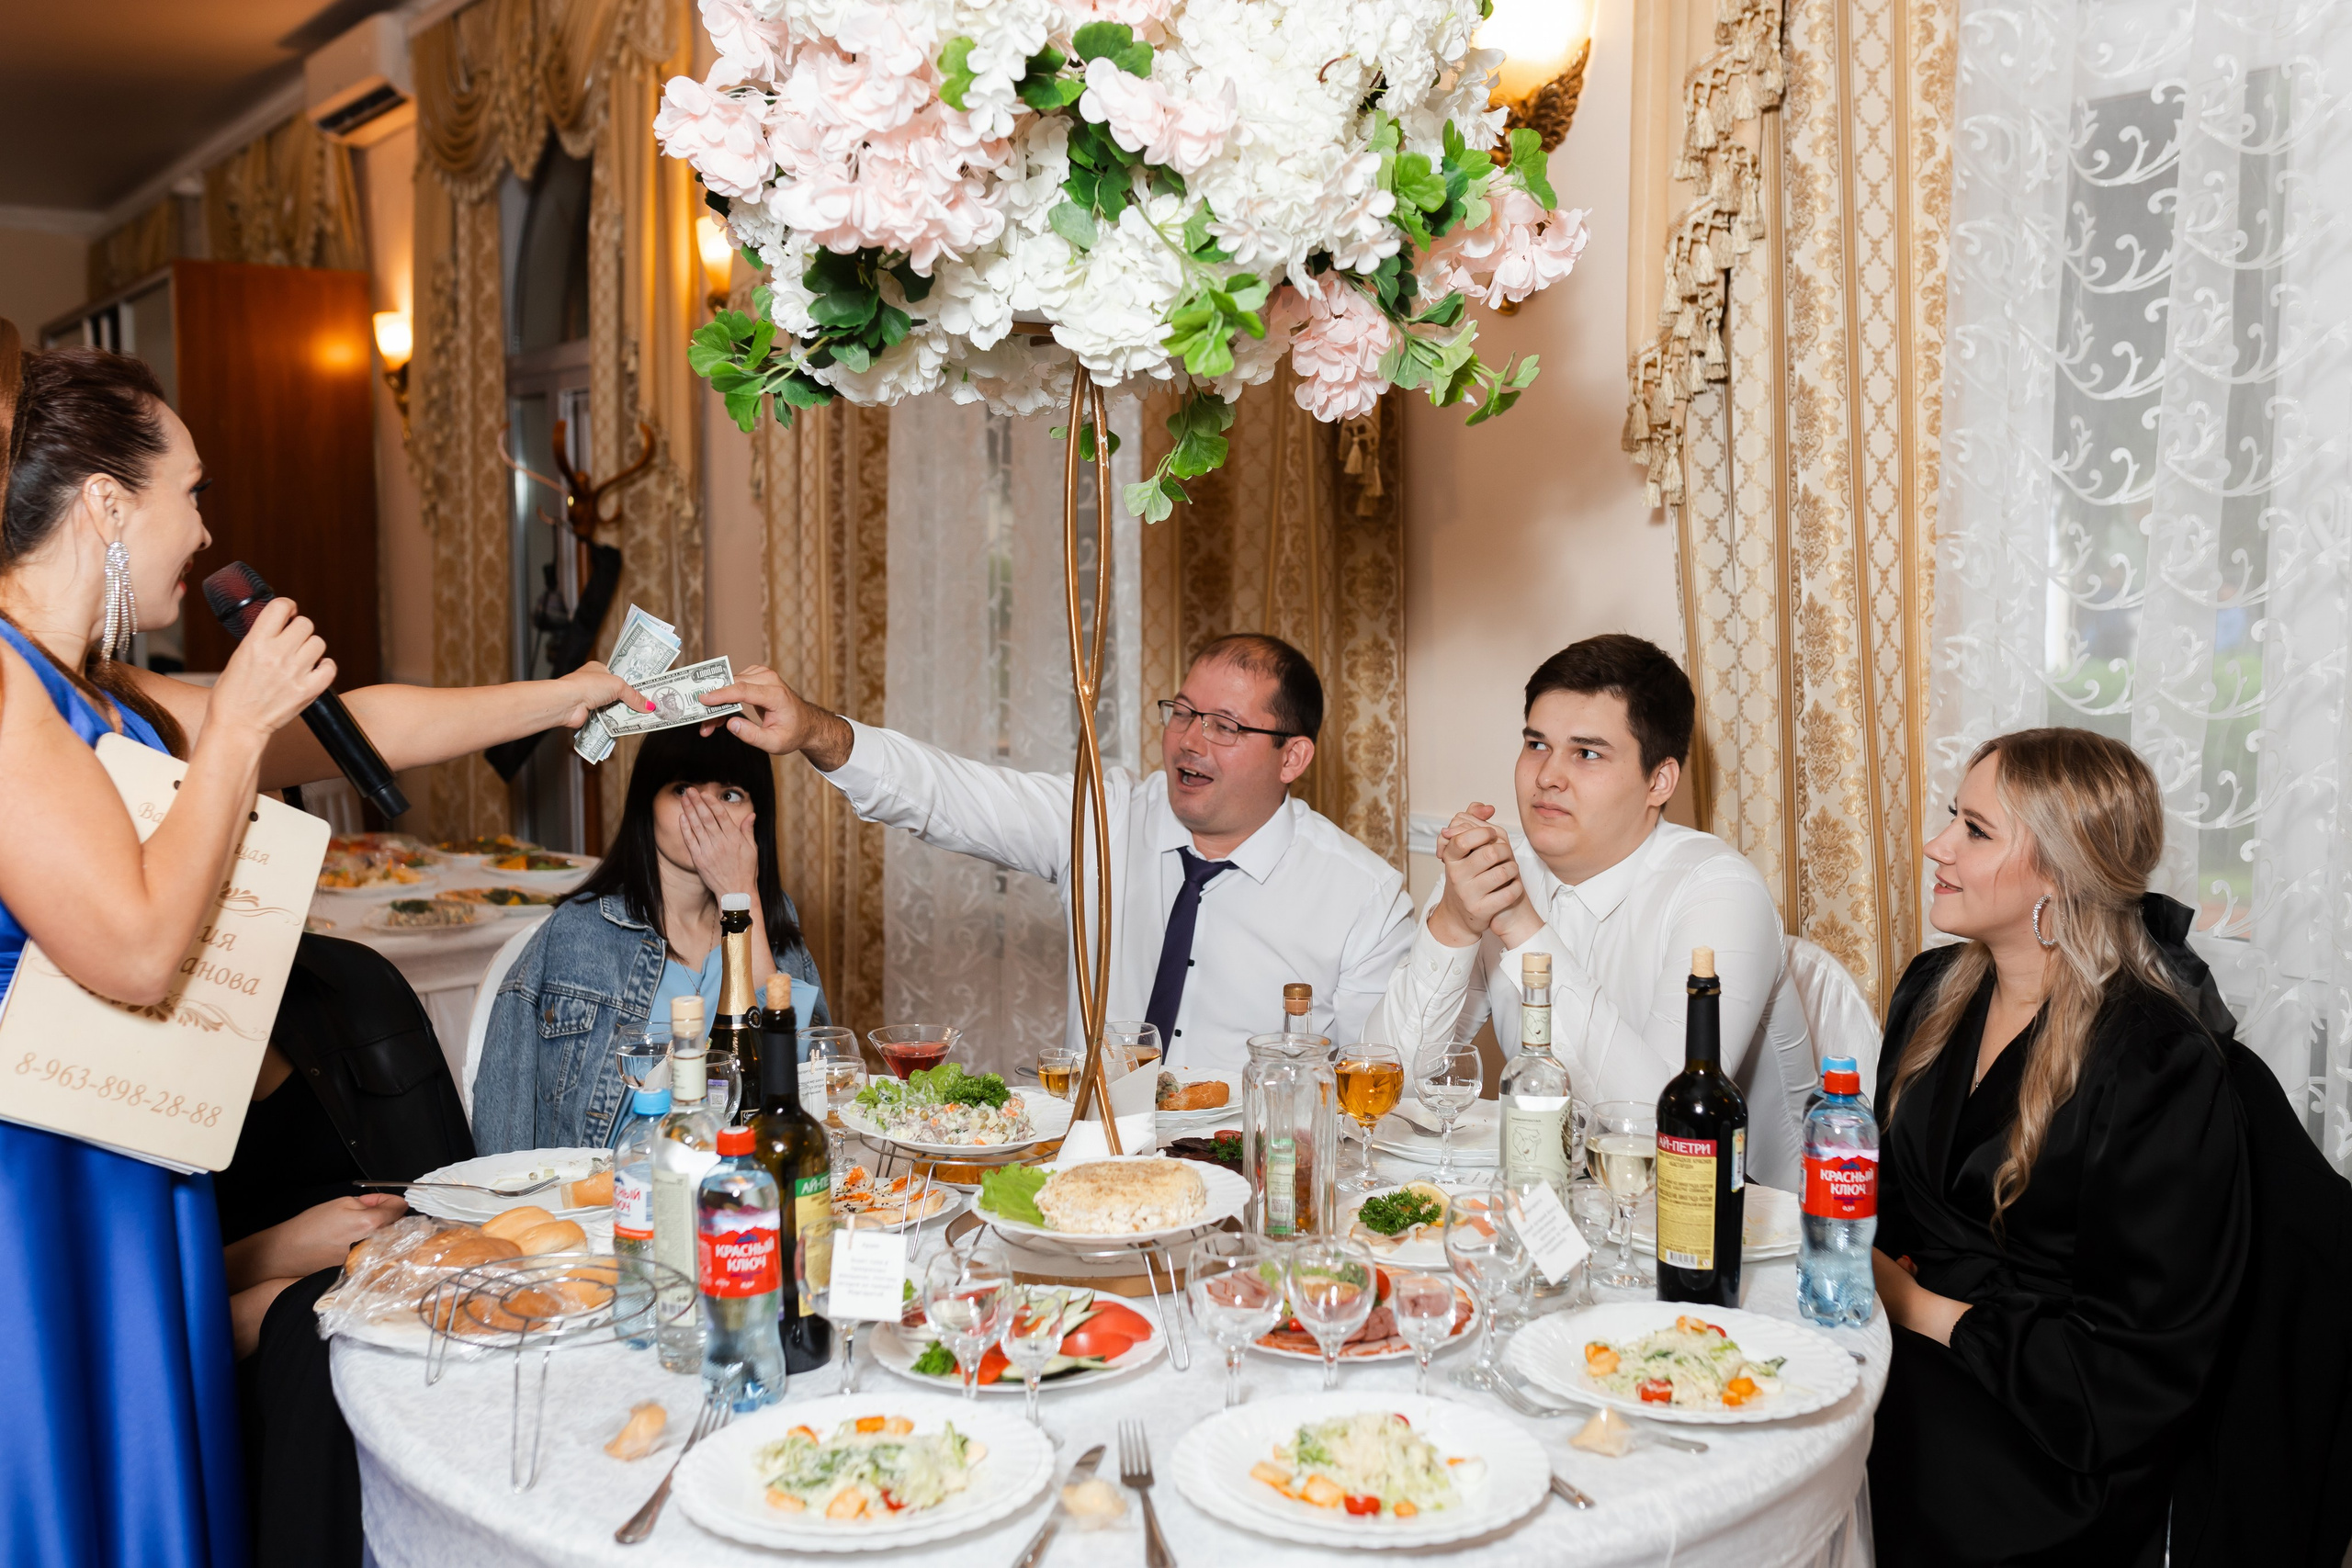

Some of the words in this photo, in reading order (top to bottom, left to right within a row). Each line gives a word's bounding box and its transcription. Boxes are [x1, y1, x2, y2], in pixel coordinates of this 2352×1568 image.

[139, 802, 164, 824] Ва
[234, 843, 270, 865] щая
[198, 925, 237, 952] ия
[181, 957, 261, 996] анова
[15, 1052, 222, 1128] 8-963-898-28-88
[1658, 1135, 1711, 1155] АЙ-ПЕТРИ
[1820, 1168, 1874, 1183] КРАСНЫЙ
[1830, 1182, 1866, 1196] КЛЮЧ
[715, 1235, 775, 1258] КРАСНЫЙ
[727, 1254, 767, 1273] КЛЮЧ
